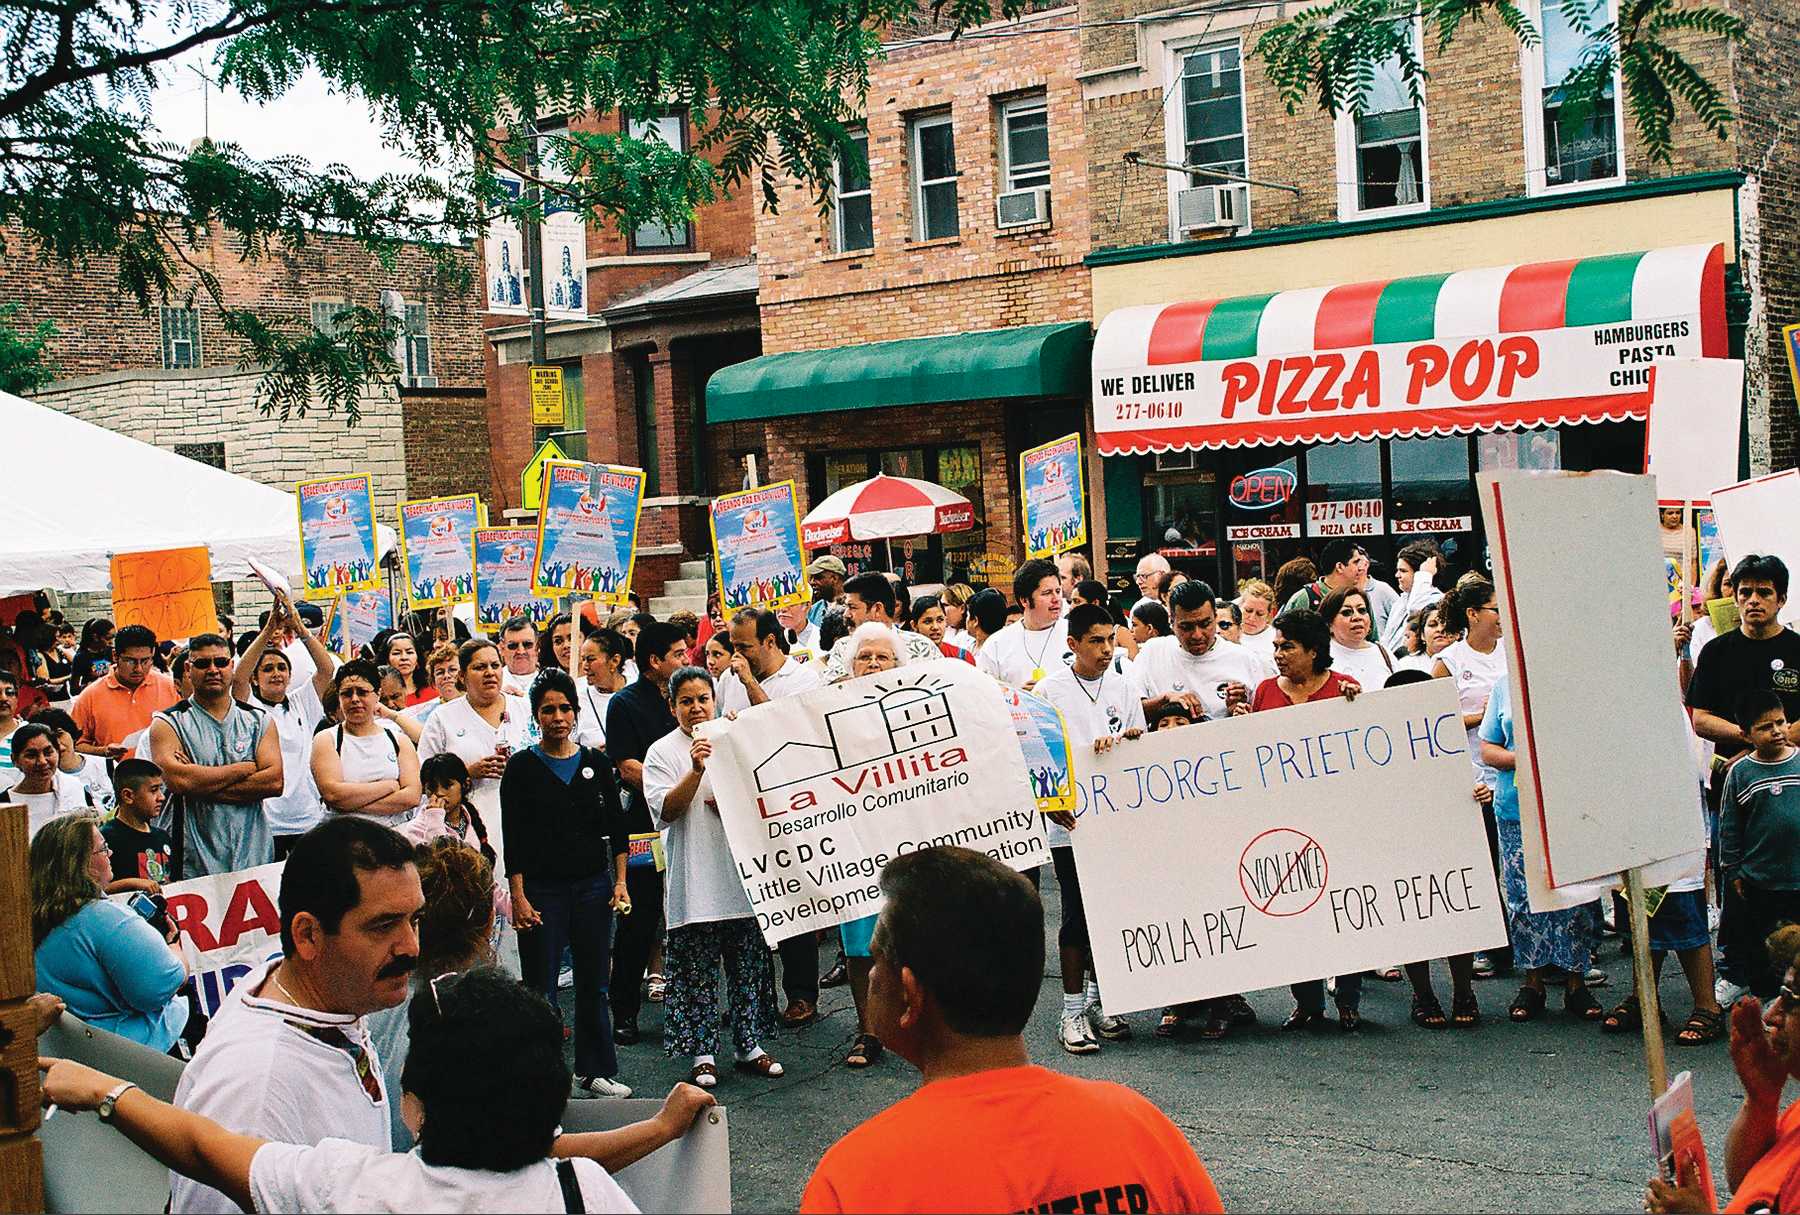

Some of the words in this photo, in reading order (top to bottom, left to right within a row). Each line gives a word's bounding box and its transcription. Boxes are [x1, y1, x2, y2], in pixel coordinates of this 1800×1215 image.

[1594, 321, 1689, 346] HAMBURGERS
[1619, 345, 1676, 364] PASTA
[1101, 378, 1124, 396] WE
[1132, 372, 1195, 394] DELIVER
[1220, 350, 1381, 419] PIZZA
[1406, 335, 1540, 405] POP
[1609, 369, 1650, 386] CHIC
[1230, 474, 1292, 504] OPEN
[1311, 500, 1382, 521] 277-0640
[1396, 519, 1415, 532] ICE
[1416, 518, 1462, 531] CREAM
[804, 525, 844, 543] Budweiser
[1231, 528, 1249, 538] ICE
[1250, 526, 1293, 538] CREAM
[1320, 524, 1344, 535] PIZZA
[1350, 523, 1373, 534] CAFE
[757, 791, 818, 819] La
[832, 747, 969, 795] Villita
[1073, 774, 1119, 818] DR.
[1123, 750, 1242, 809] JORGE
[1256, 725, 1392, 789] PRIETO
[768, 802, 857, 839] Desarrollo
[862, 771, 969, 811] Comunitario
[747, 877, 801, 906] Little
[806, 853, 889, 887] Village
[1241, 846, 1325, 899] VIOLENCE
[757, 885, 880, 931] Developme
[1329, 884, 1389, 934] FOR
[1394, 866, 1481, 922] PEACE
[1122, 924, 1165, 972] POR
[1166, 918, 1201, 963] LA
[1203, 905, 1257, 956] PAZ
